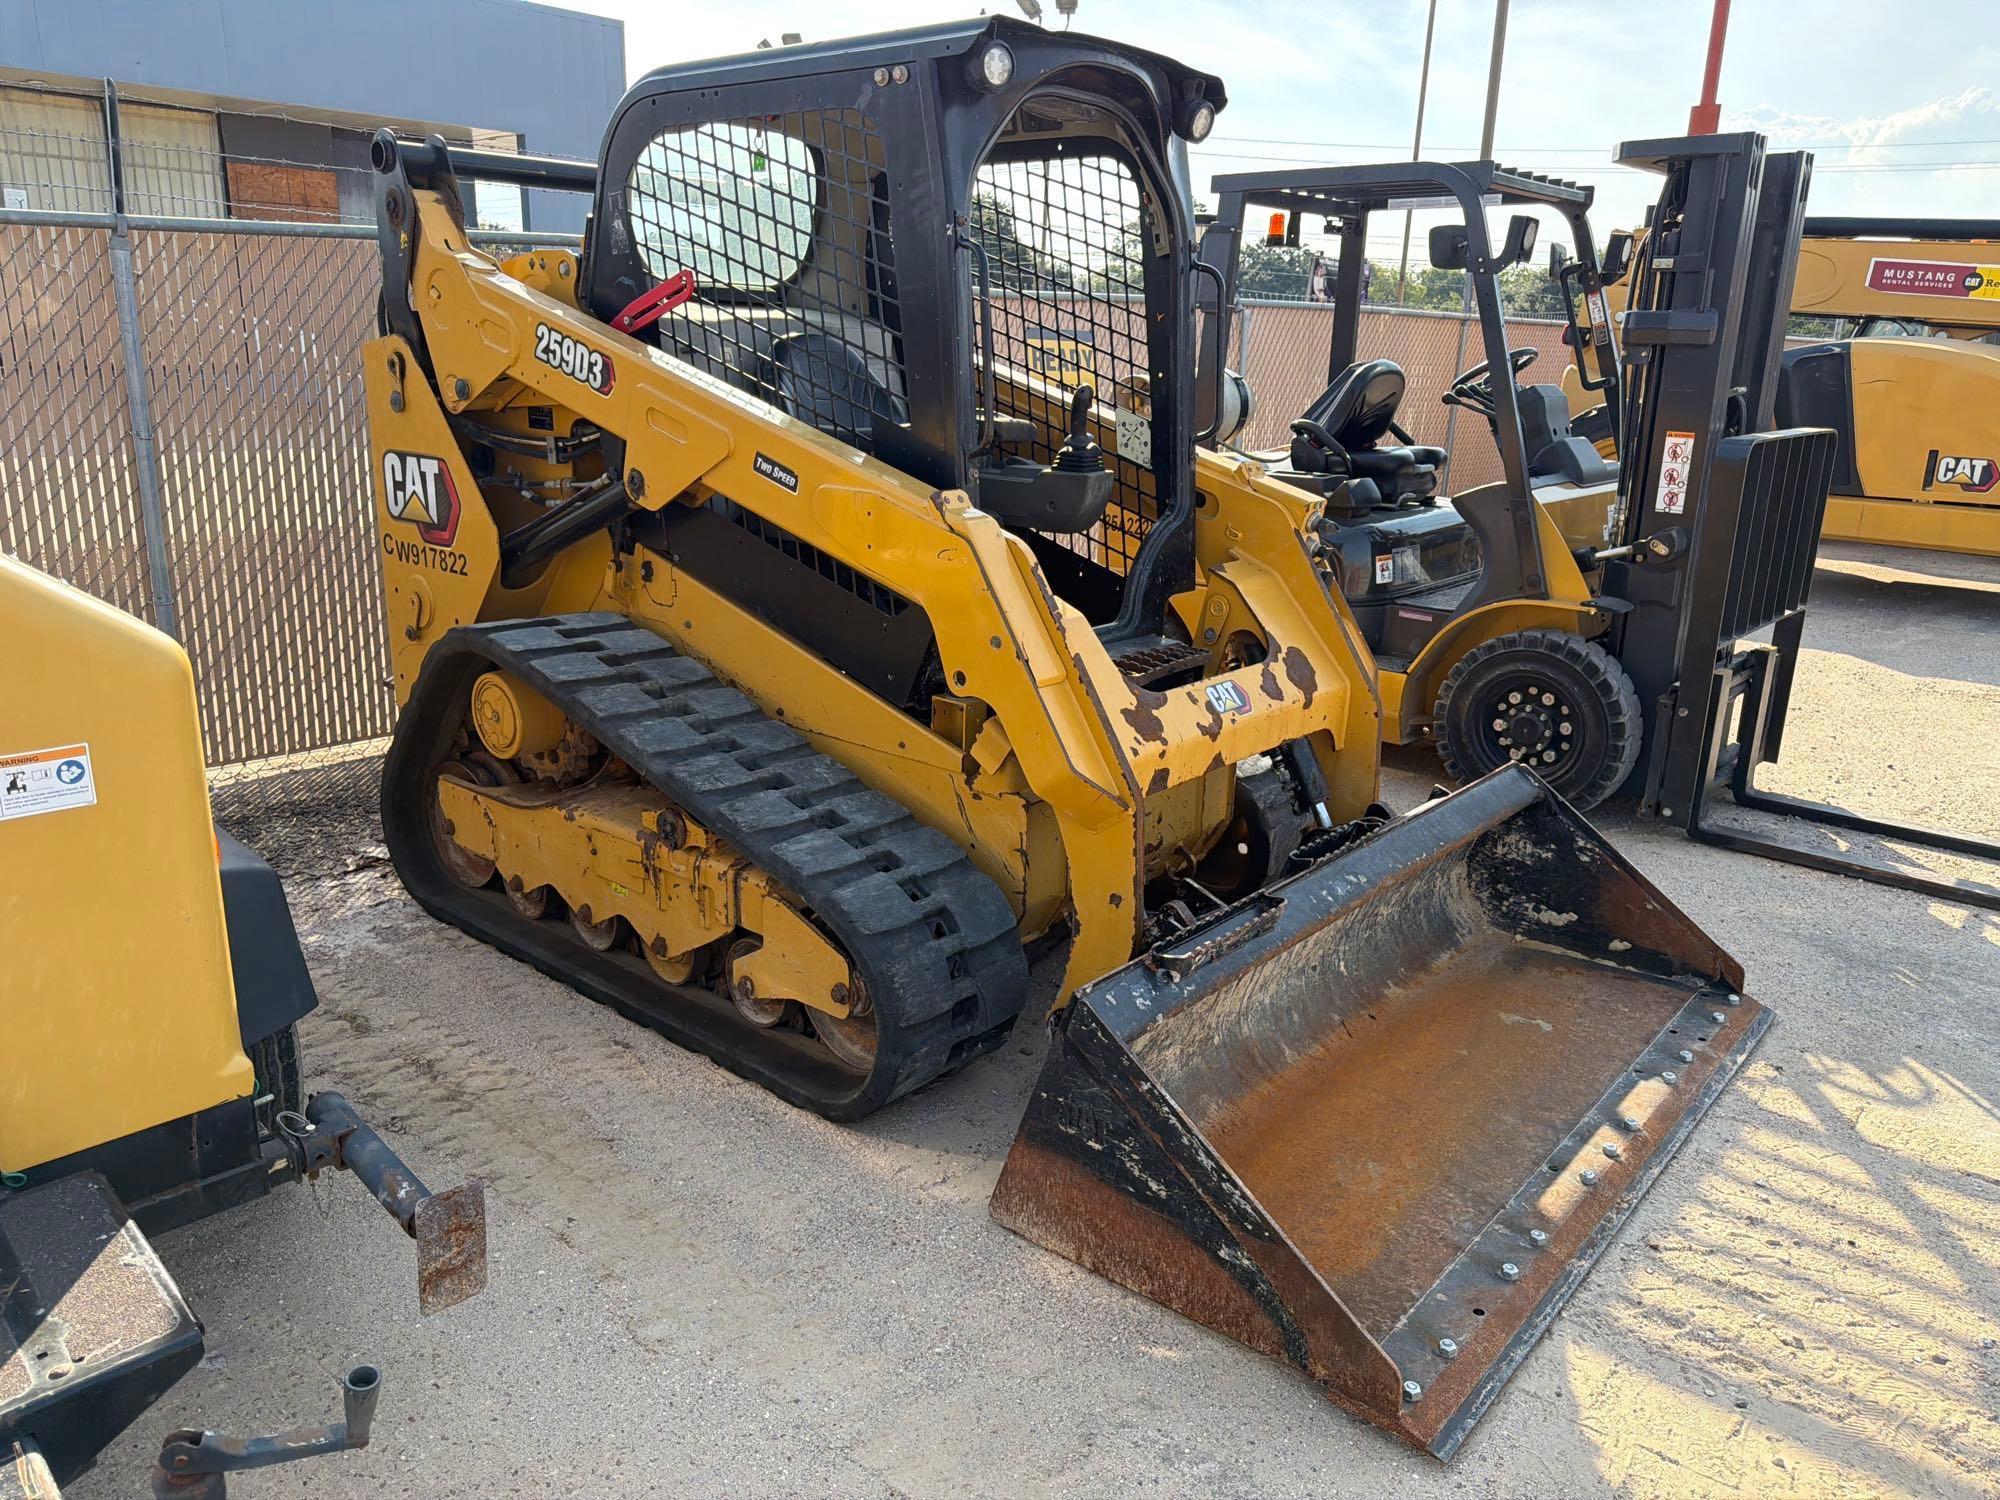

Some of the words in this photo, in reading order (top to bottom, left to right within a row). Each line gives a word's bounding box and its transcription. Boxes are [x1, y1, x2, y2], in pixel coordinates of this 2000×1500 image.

[1883, 268, 1956, 282] MUSTANG
[1964, 277, 1981, 287] CAT
[535, 324, 603, 389] 259D3
[1937, 457, 1988, 485] CAT
[384, 452, 439, 524] CAT
[383, 533, 468, 577] CW917822
[1205, 681, 1243, 713] CAT
